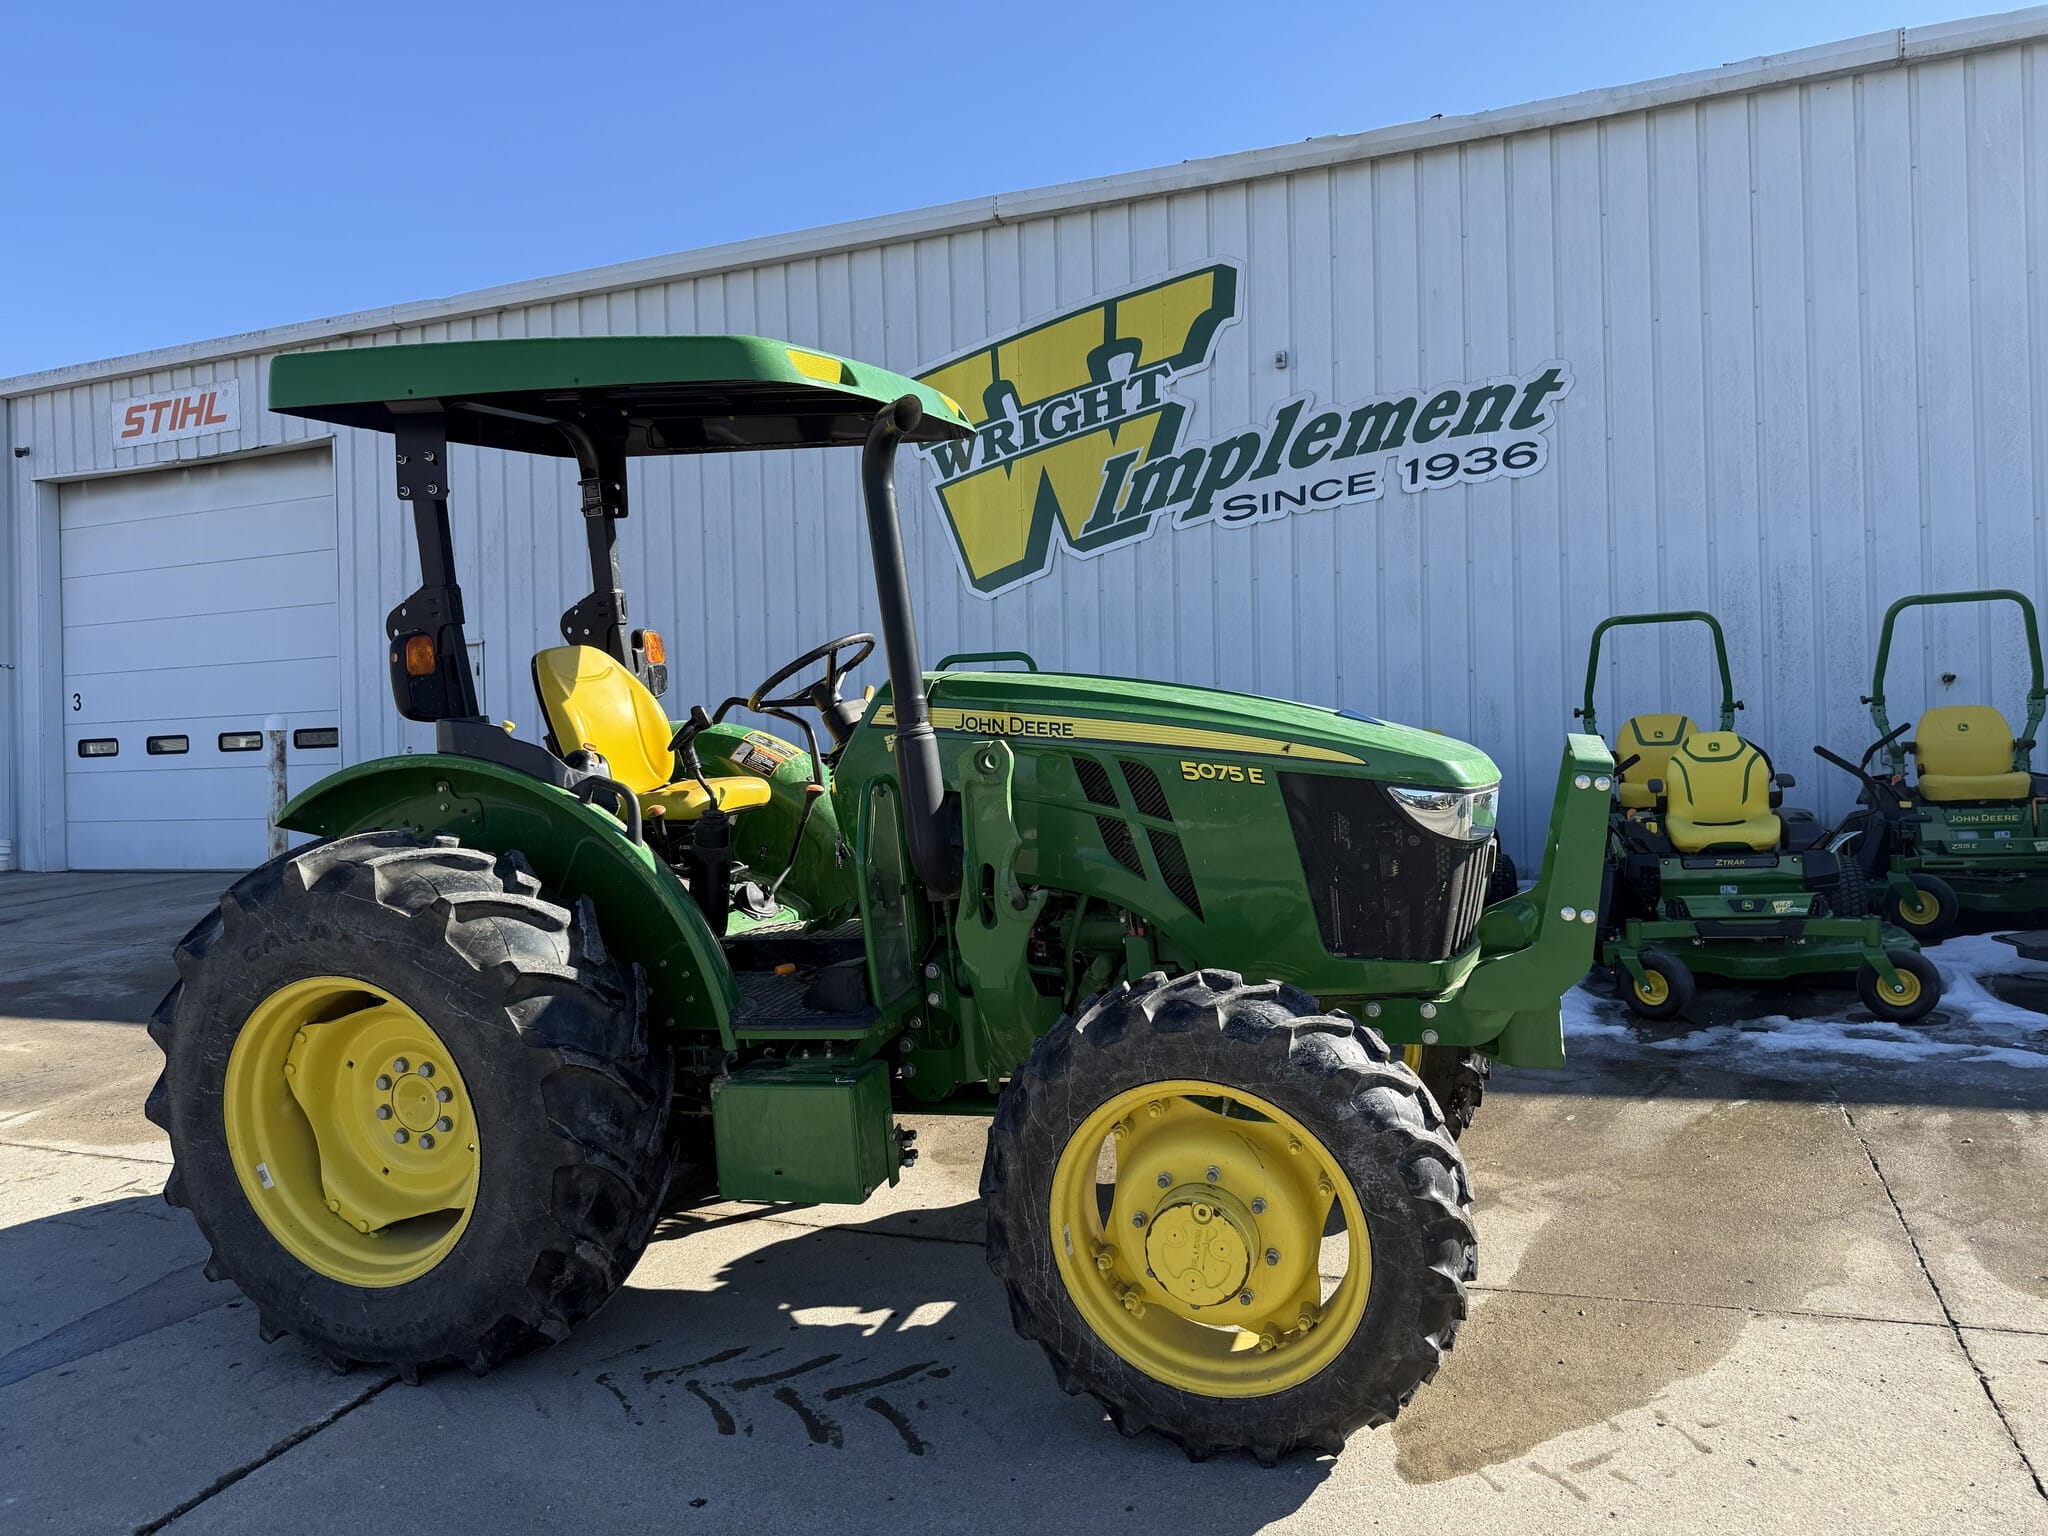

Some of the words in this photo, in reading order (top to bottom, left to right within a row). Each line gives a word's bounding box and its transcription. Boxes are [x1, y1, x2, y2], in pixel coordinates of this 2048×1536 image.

[121, 391, 228, 438] STIHL
[930, 367, 1170, 480] WRIGHT
[1081, 368, 1566, 534] Implement
[1222, 470, 1377, 521] SINCE
[1404, 440, 1539, 485] 1936
[72, 692, 82, 712] 3
[954, 713, 1005, 733] JOHN
[1009, 716, 1075, 737] DEERE
[1180, 760, 1245, 782] 5075
[1247, 766, 1266, 785] E
[1949, 815, 1979, 823] JOHN
[1981, 814, 2020, 822] DEERE
[1715, 858, 1746, 866] ZTRAK
